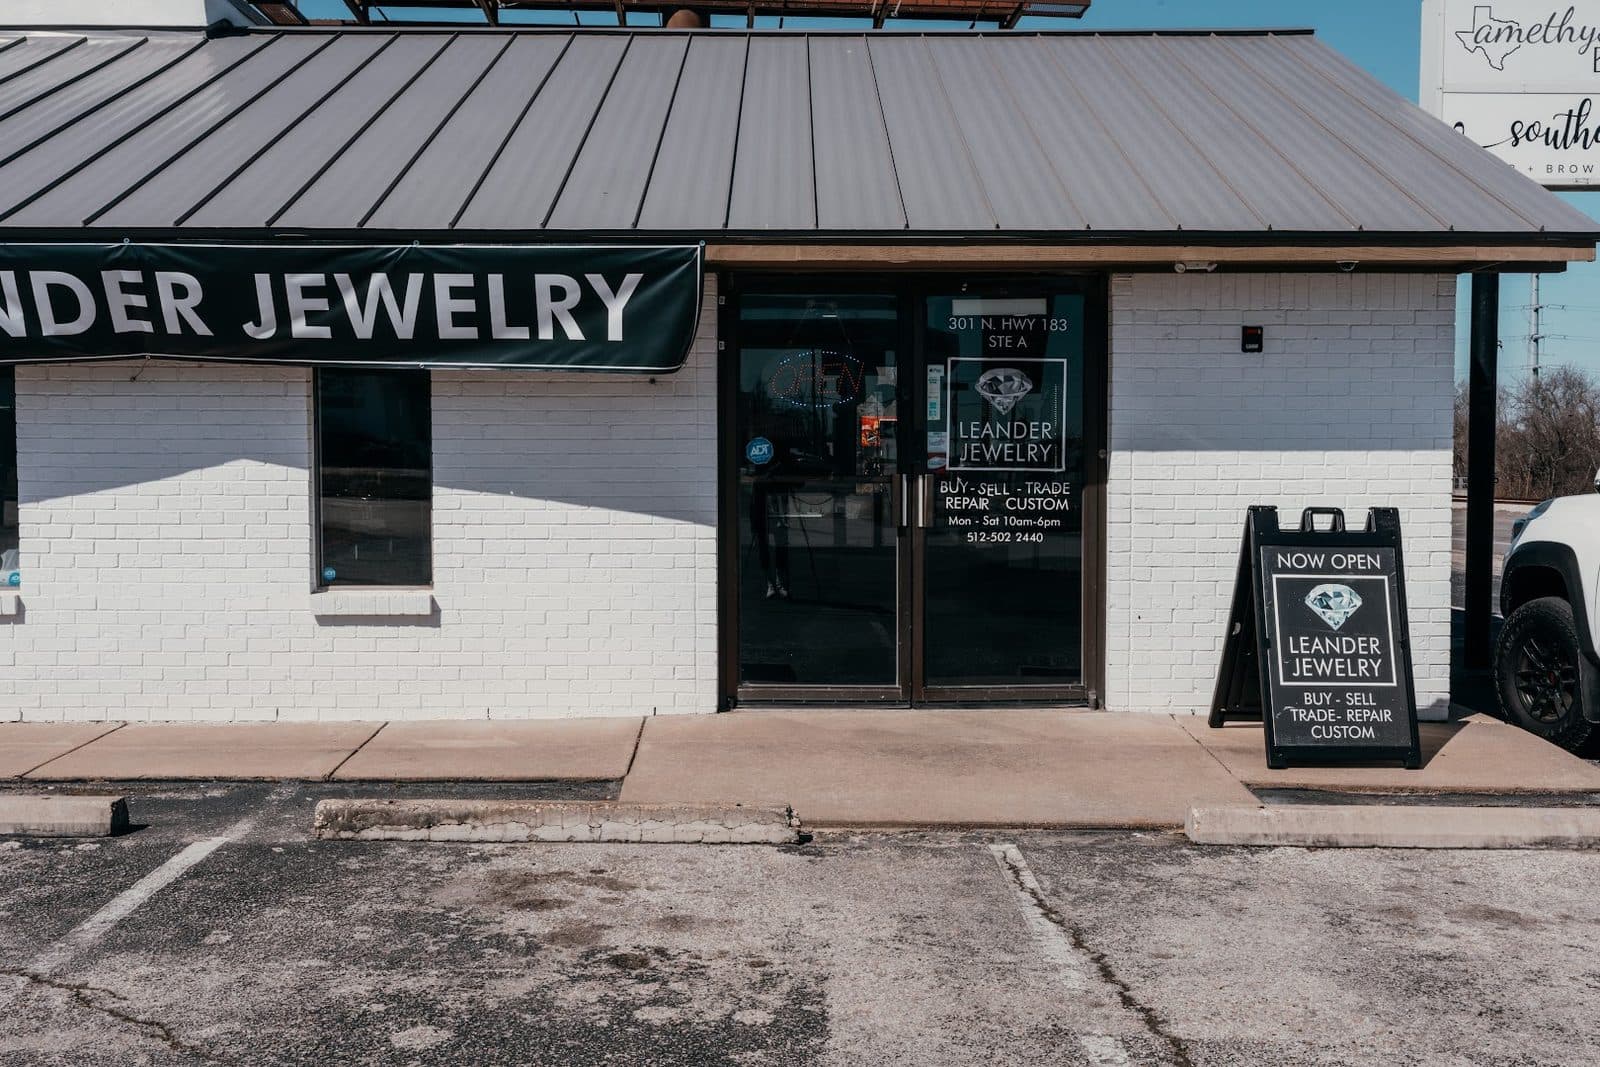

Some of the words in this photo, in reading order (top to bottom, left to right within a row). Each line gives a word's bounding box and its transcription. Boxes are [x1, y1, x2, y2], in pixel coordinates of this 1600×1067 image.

[1473, 6, 1600, 55] amethy
[1546, 164, 1594, 174] BROW
[242, 272, 643, 342] JEWELRY
[949, 317, 974, 330] 301
[981, 318, 996, 330] N.
[1001, 318, 1036, 331] HWY
[1042, 318, 1068, 331] 183
[988, 335, 1013, 348] STE
[1017, 335, 1028, 348] A
[959, 421, 1052, 440] LEANDER
[960, 443, 1052, 462] JEWELRY
[977, 483, 1010, 497] SELL
[1025, 481, 1071, 495] TRADE
[945, 497, 990, 510] REPAIR
[1005, 498, 1069, 511] CUSTOM
[948, 516, 972, 526] Mon
[982, 516, 1000, 526] Sat
[1003, 516, 1061, 528] 10am-6pm
[967, 532, 1011, 543] 512-502
[1016, 532, 1044, 543] 2440
[1277, 553, 1325, 569] NOW
[1331, 553, 1381, 570] OPEN
[1289, 636, 1381, 655] LEANDER
[1292, 658, 1382, 677] JEWELRY
[1304, 692, 1332, 706] BUY
[1345, 692, 1376, 706] SELL
[1347, 709, 1393, 722] REPAIR
[1311, 725, 1375, 739] CUSTOM
